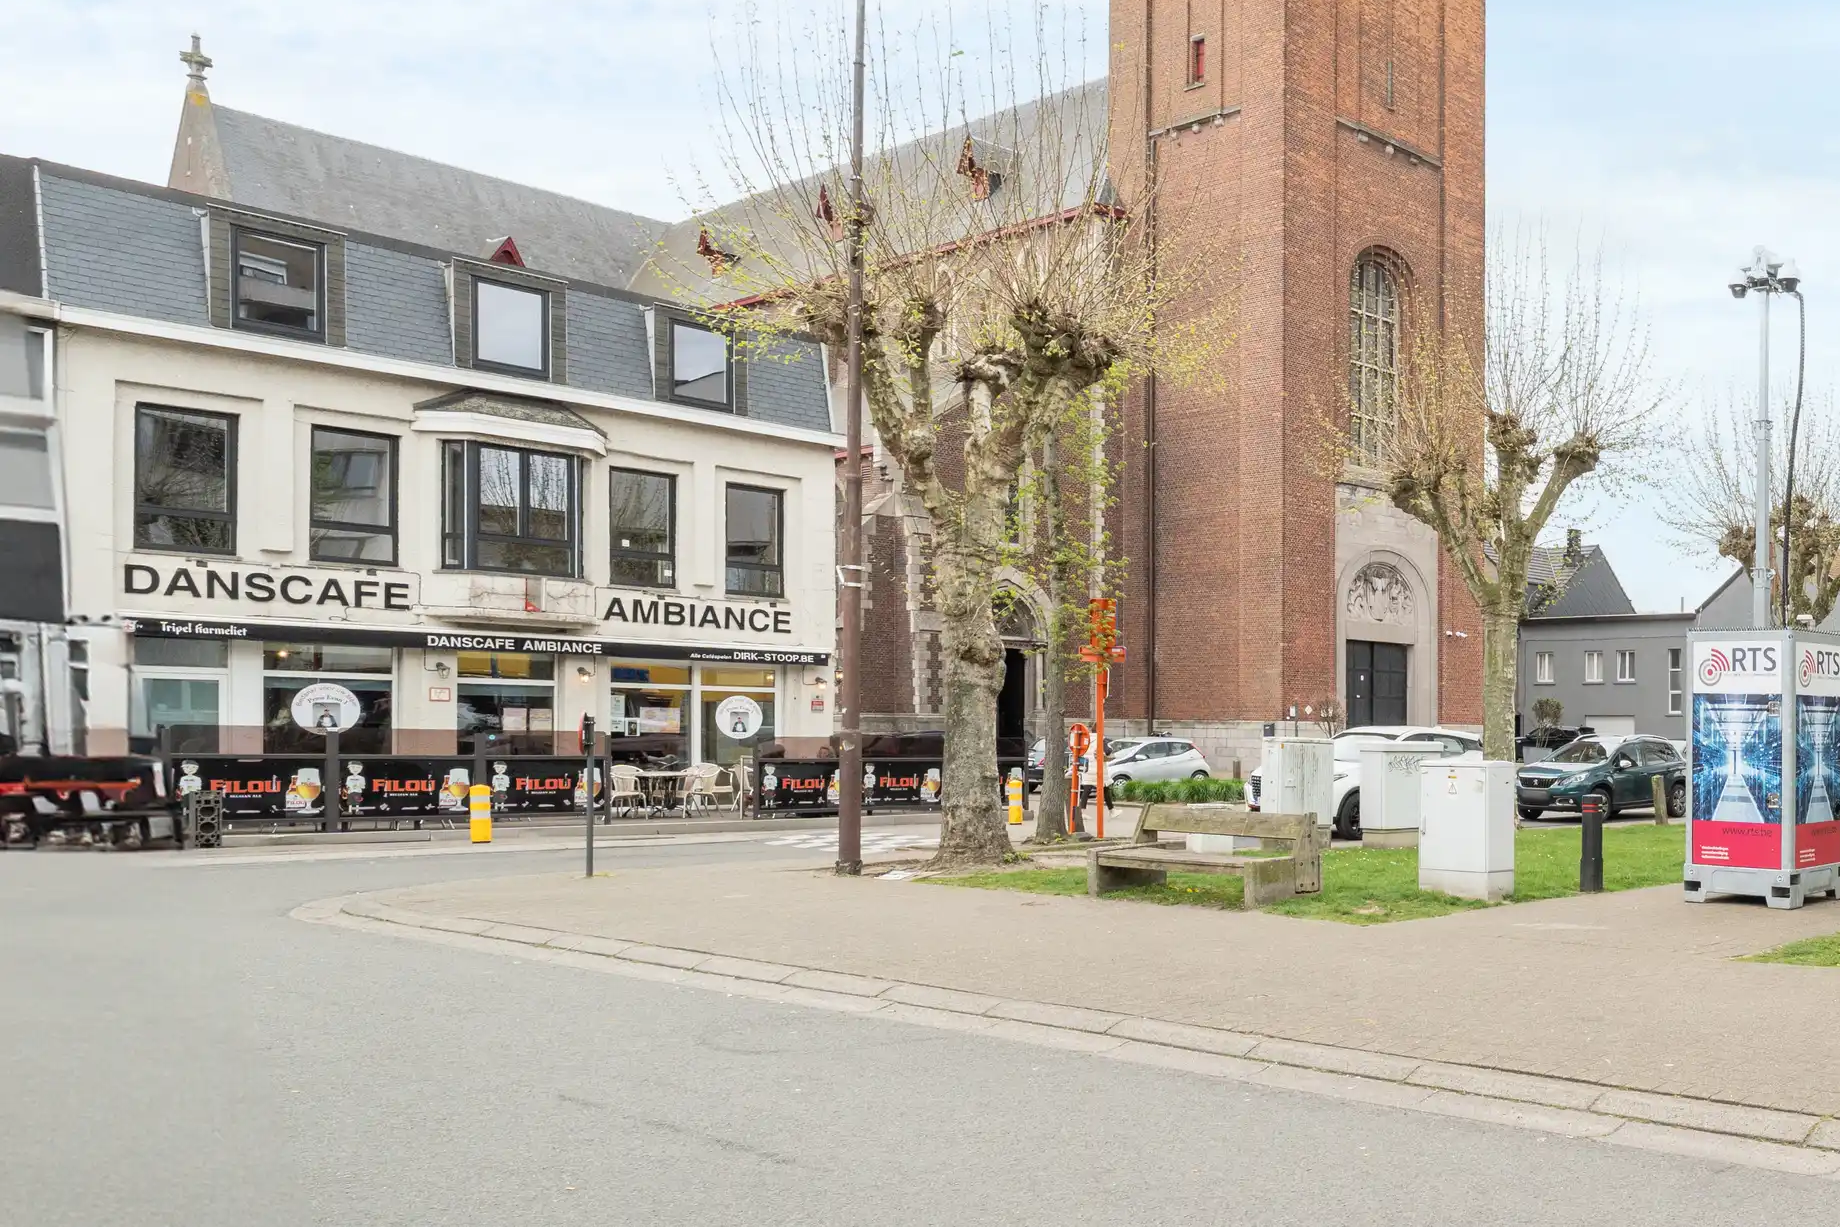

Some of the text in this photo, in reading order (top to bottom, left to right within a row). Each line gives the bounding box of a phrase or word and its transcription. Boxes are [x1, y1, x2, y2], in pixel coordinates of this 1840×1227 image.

[124, 563, 410, 610] DANSCAFE
[603, 597, 791, 634] AMBIANCE
[160, 621, 248, 636] Tripel Karmeliet
[427, 635, 602, 654] DANSCAFE AMBIANCE
[1732, 647, 1777, 672] RTS
[1817, 650, 1840, 676] RTS
[210, 779, 281, 793] FILOU
[372, 779, 436, 792] FILOU
[515, 777, 571, 791] FILOU
[781, 778, 825, 789] FILOU
[879, 776, 919, 788] FILOU
